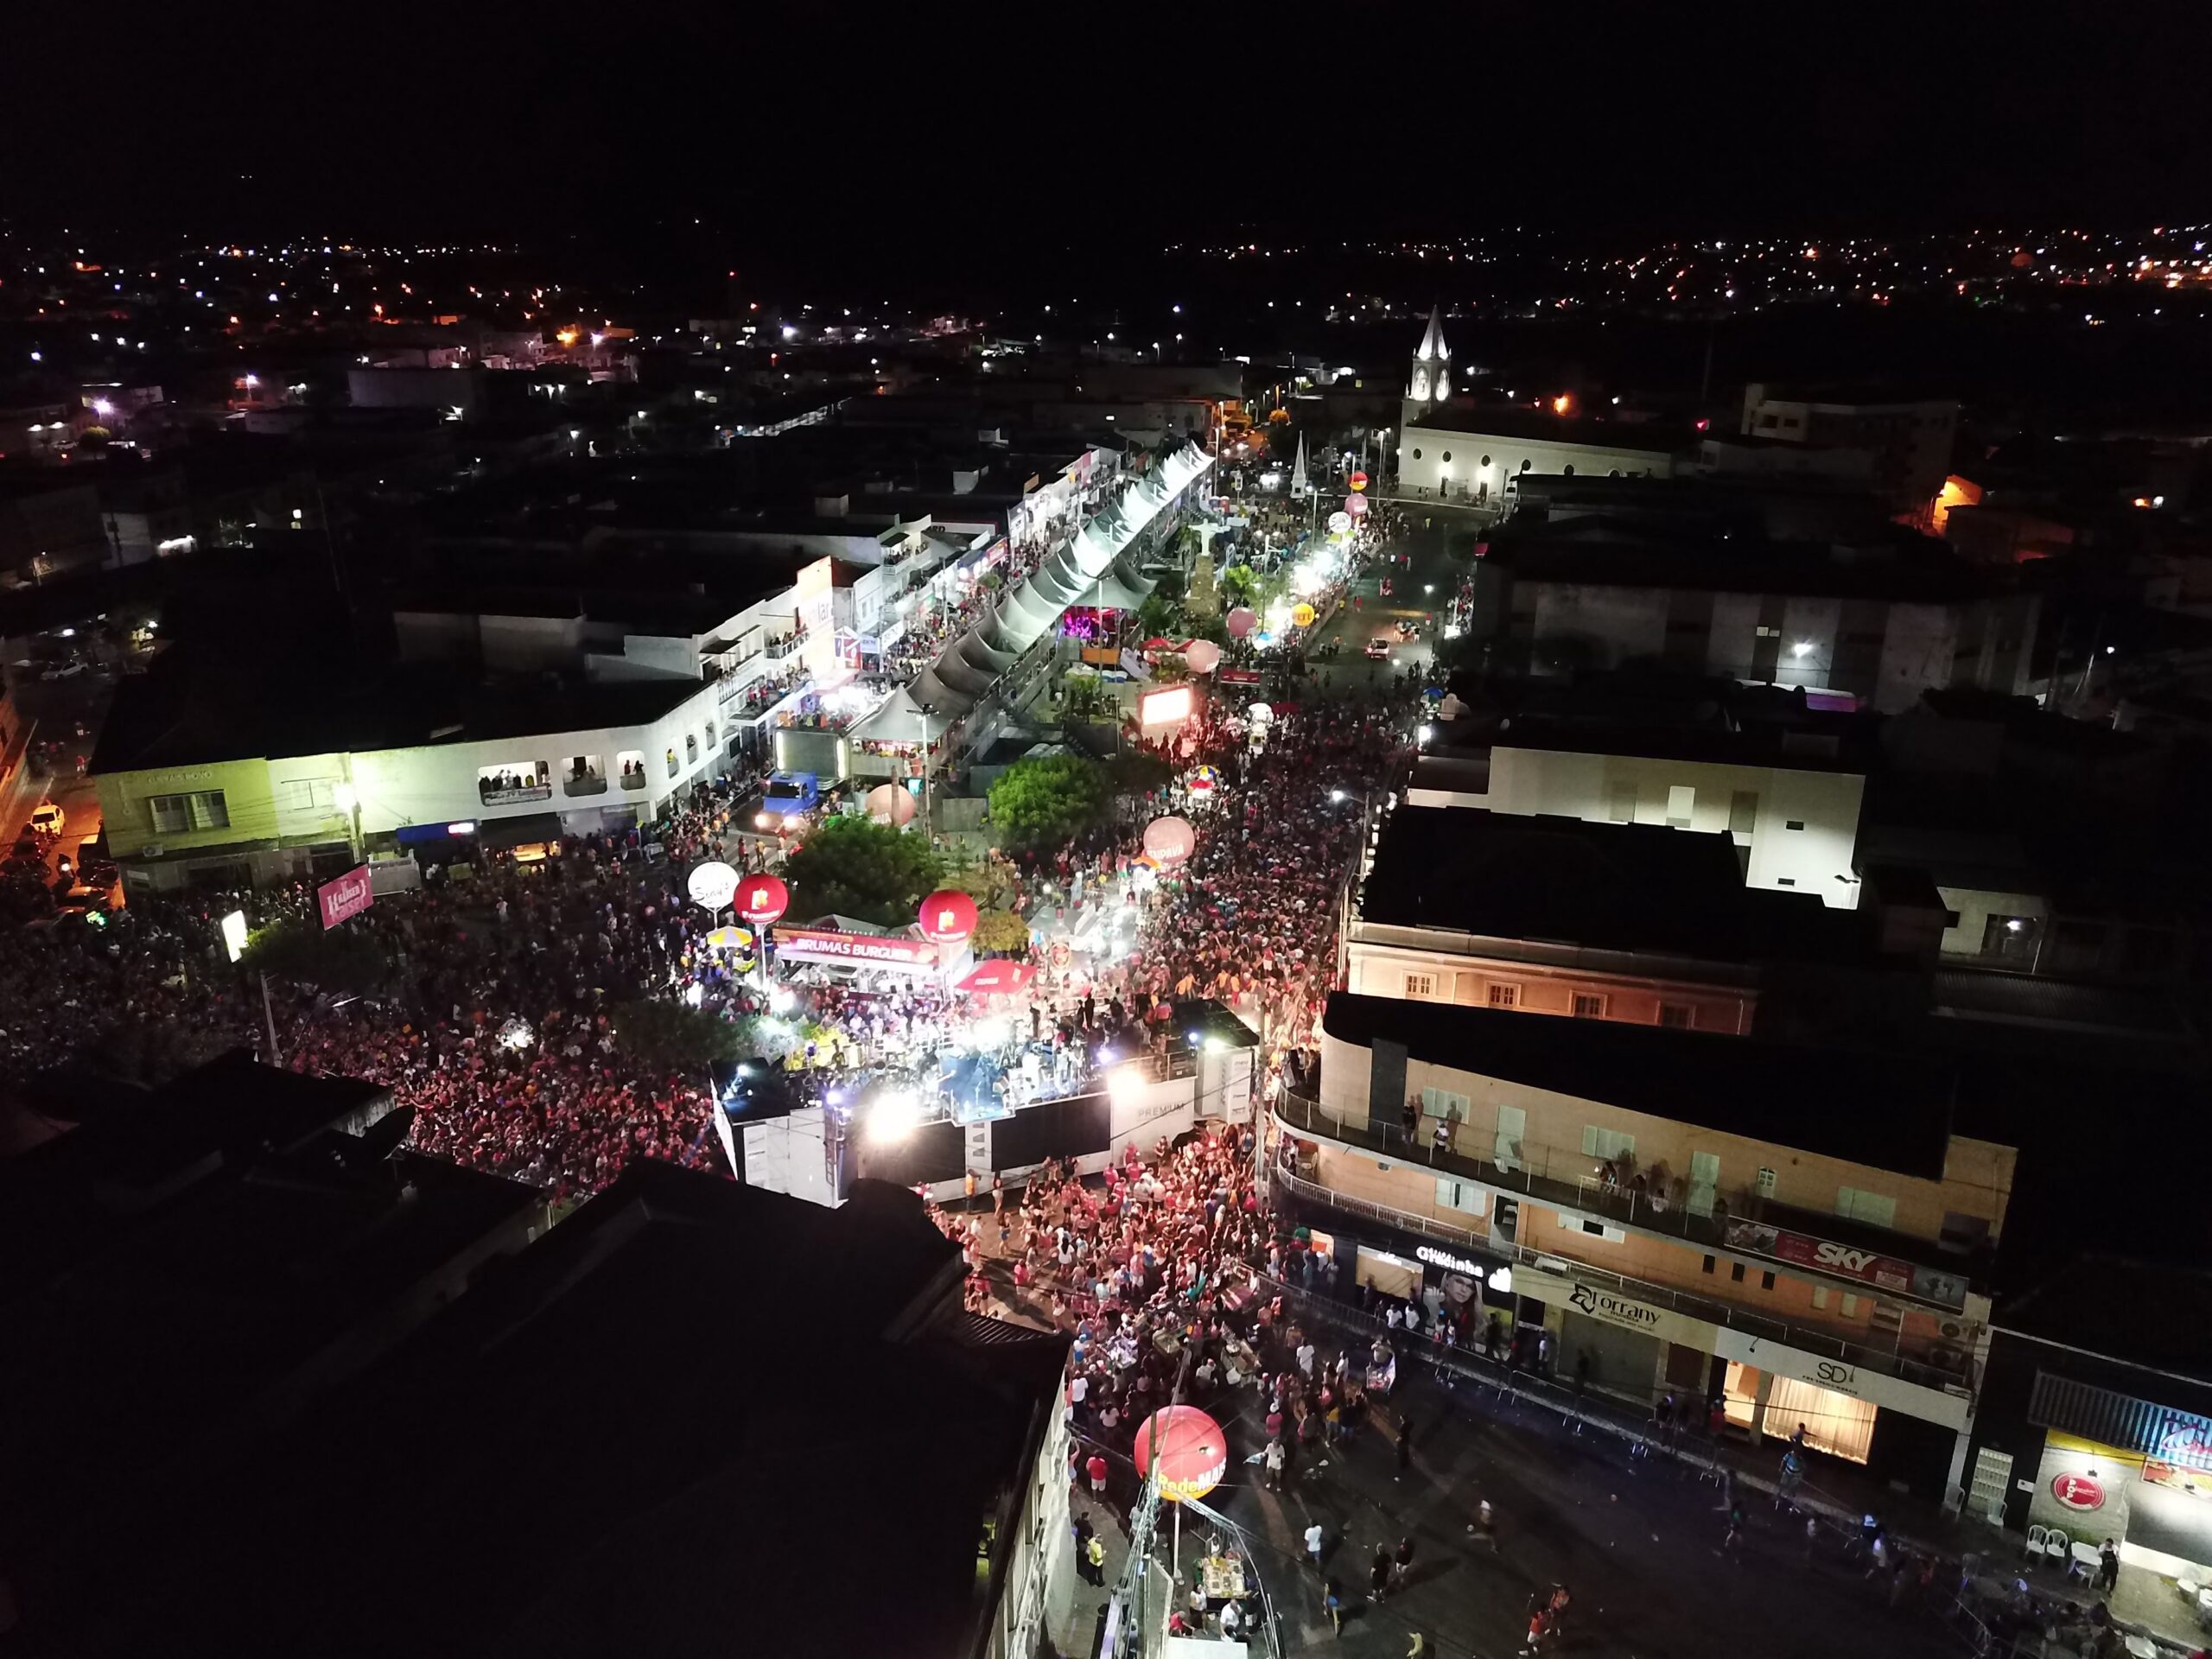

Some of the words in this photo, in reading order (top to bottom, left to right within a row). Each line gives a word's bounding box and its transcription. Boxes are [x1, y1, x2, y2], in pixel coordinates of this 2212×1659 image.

[796, 938, 851, 955] BRUMAS
[1138, 1103, 1185, 1117] PREMIUM
[1813, 1243, 1878, 1272] SKY
[1817, 1362, 1847, 1382] SD
